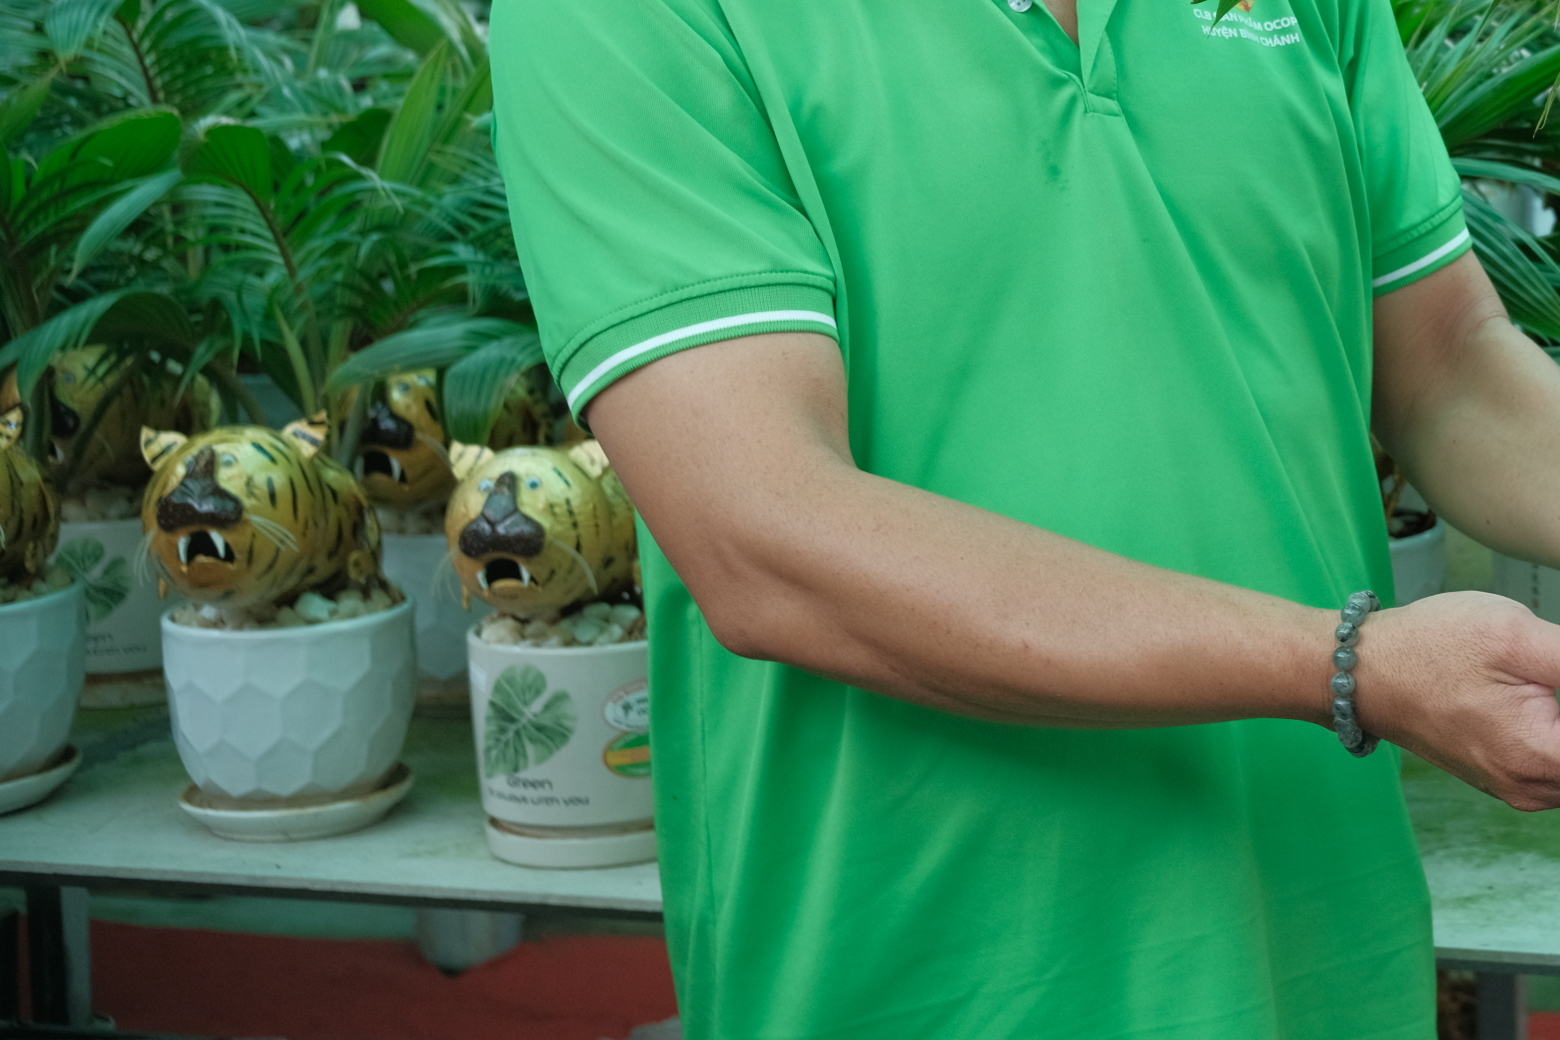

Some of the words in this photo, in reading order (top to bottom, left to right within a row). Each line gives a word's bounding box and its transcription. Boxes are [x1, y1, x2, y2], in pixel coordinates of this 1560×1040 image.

[1193, 8, 1213, 21] CLB
[1263, 16, 1299, 32] OCOP
[1201, 25, 1239, 40] HUYỆN
[1259, 33, 1301, 48] CHÁNH
[504, 773, 554, 792] Green
[560, 794, 591, 807] you
